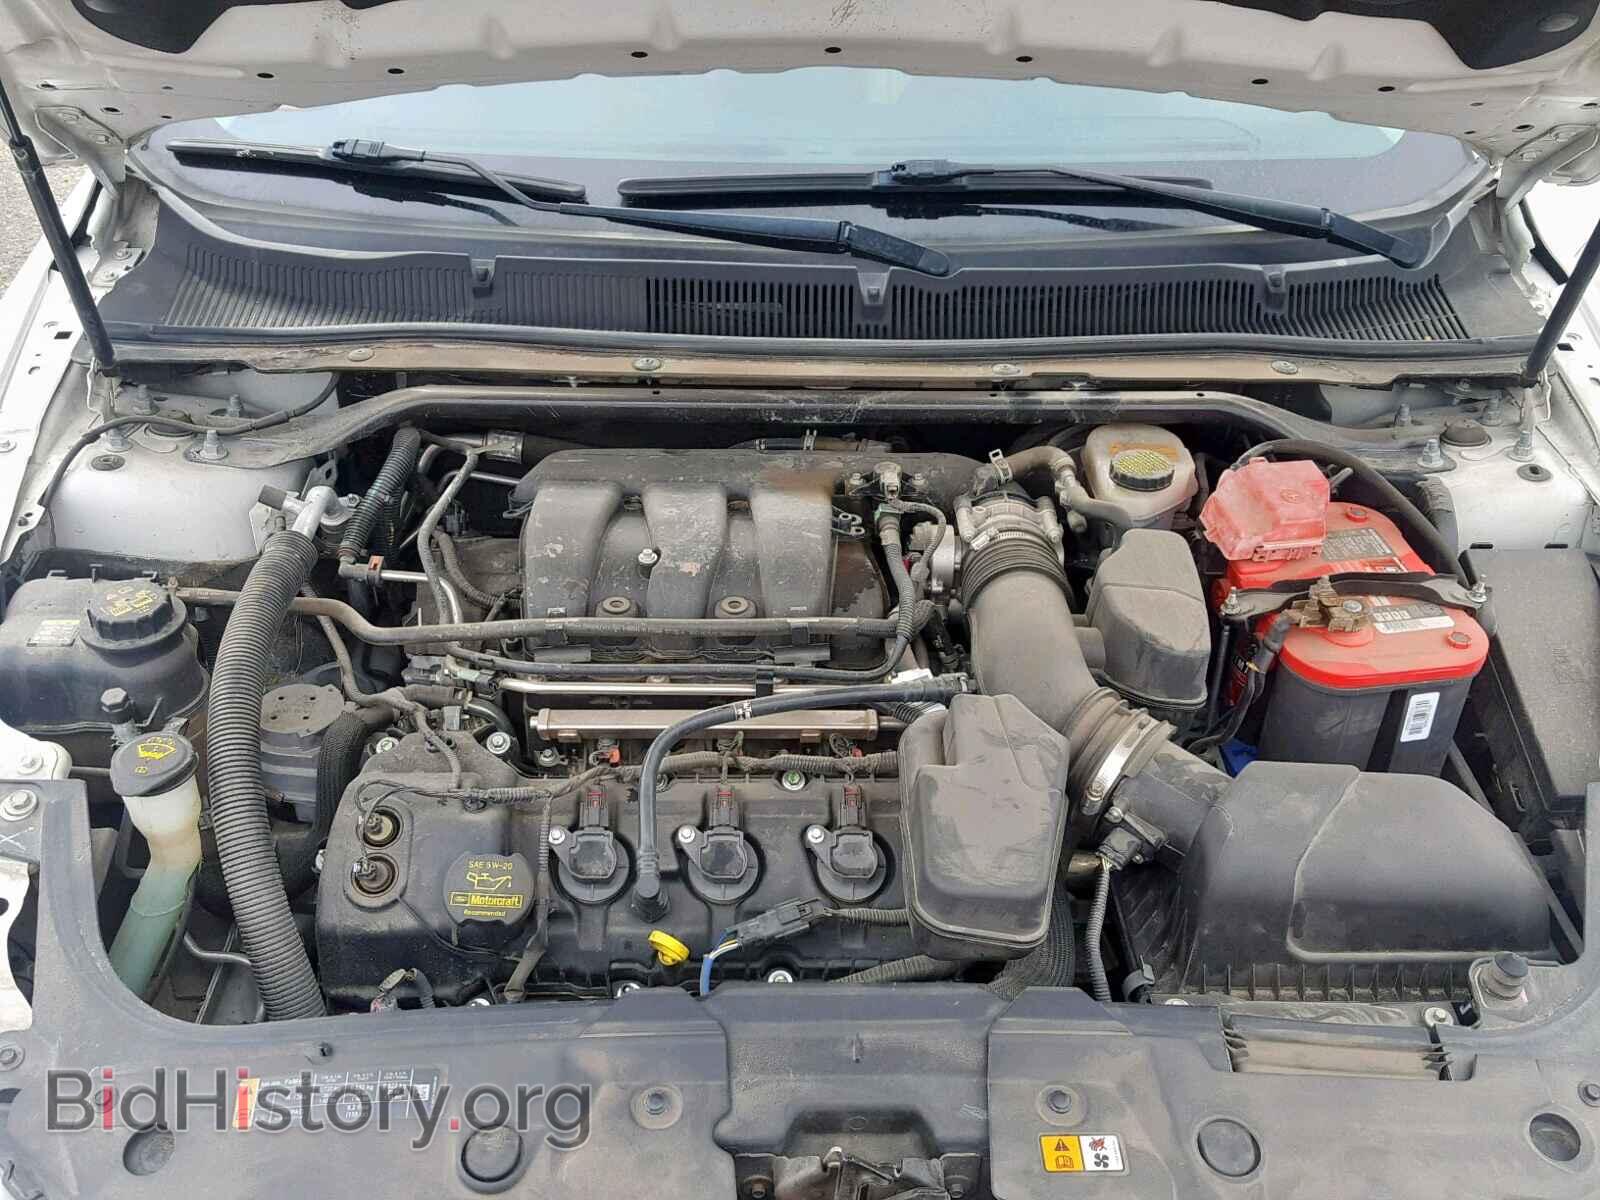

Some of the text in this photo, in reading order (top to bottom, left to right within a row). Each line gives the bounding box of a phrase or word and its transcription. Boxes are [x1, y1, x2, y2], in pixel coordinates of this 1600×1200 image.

[468, 860, 513, 871] SAE 5W-20
[470, 895, 521, 906] Motorcraft
